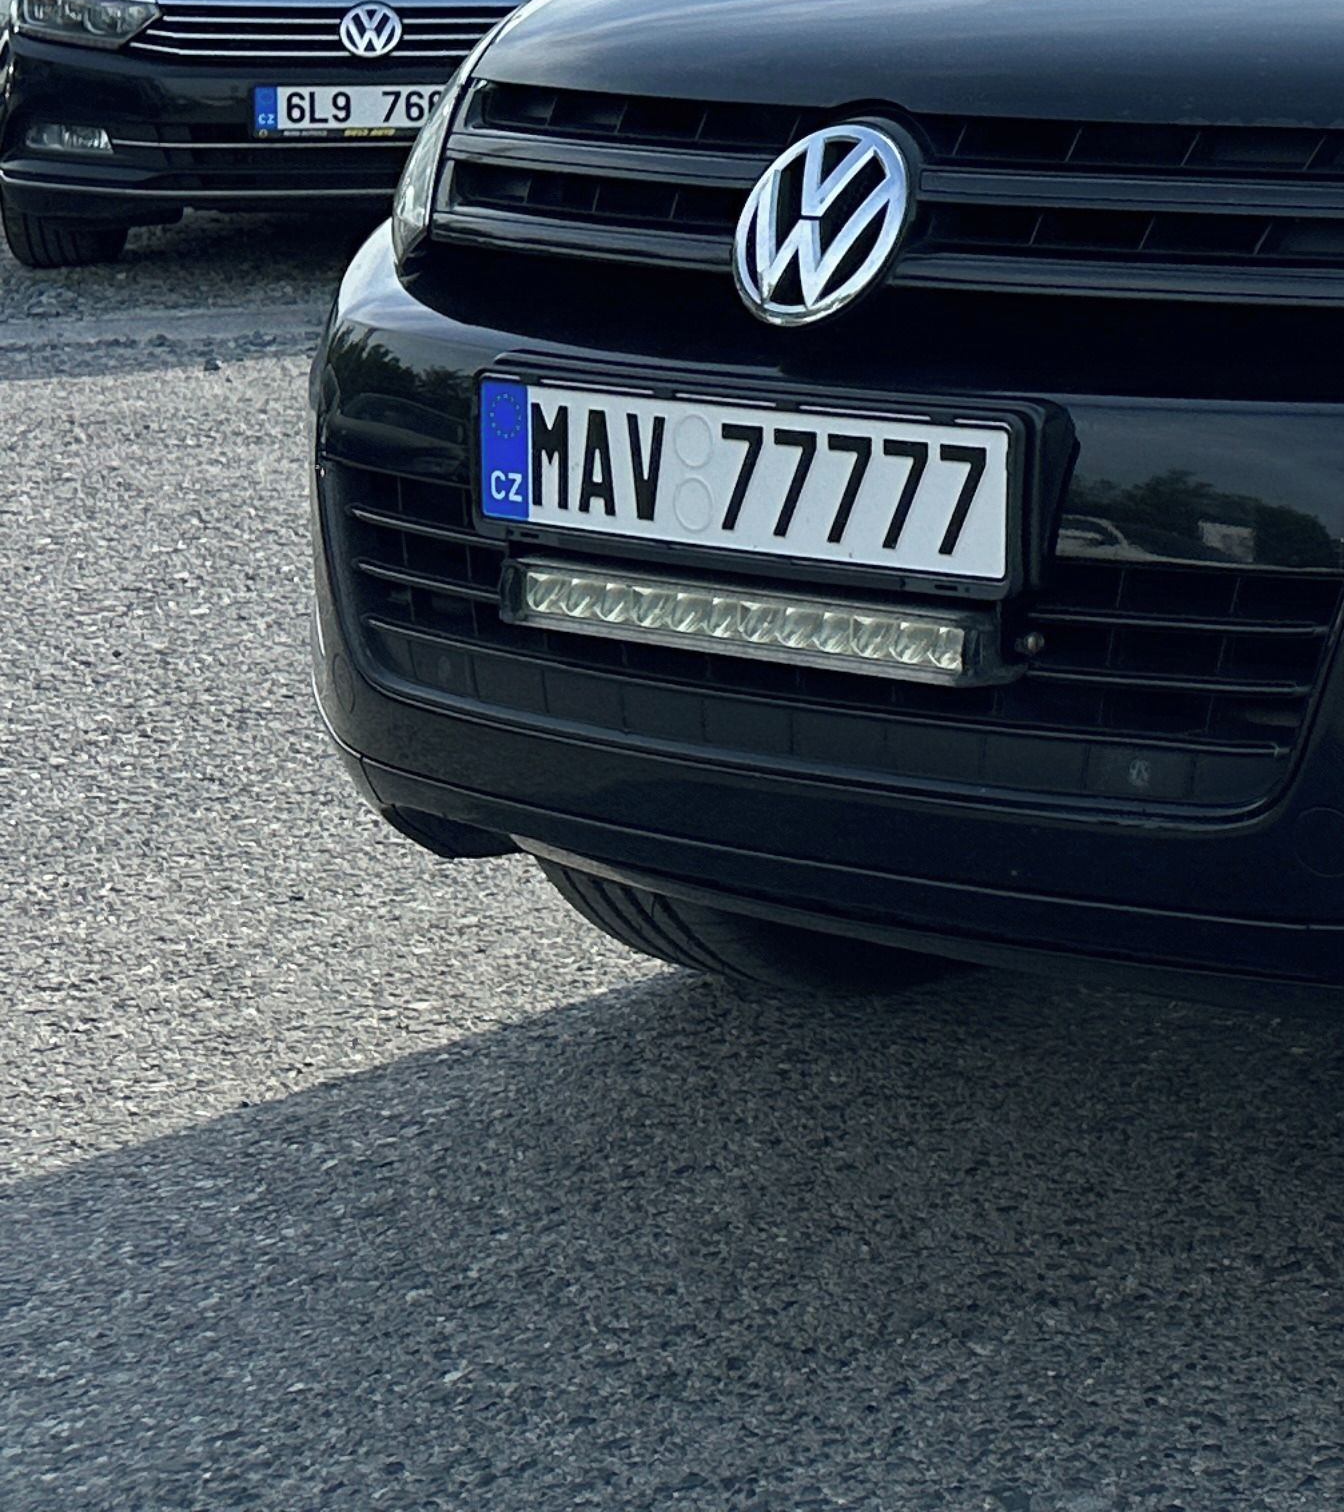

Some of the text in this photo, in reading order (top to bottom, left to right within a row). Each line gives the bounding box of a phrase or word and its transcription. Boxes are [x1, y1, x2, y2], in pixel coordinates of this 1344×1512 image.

[342, 3, 401, 56] VW
[257, 113, 276, 125] CZ
[286, 91, 352, 124] 6L9
[741, 129, 905, 317] VW
[490, 470, 523, 503] CZ
[530, 401, 987, 556] MAV 77777
